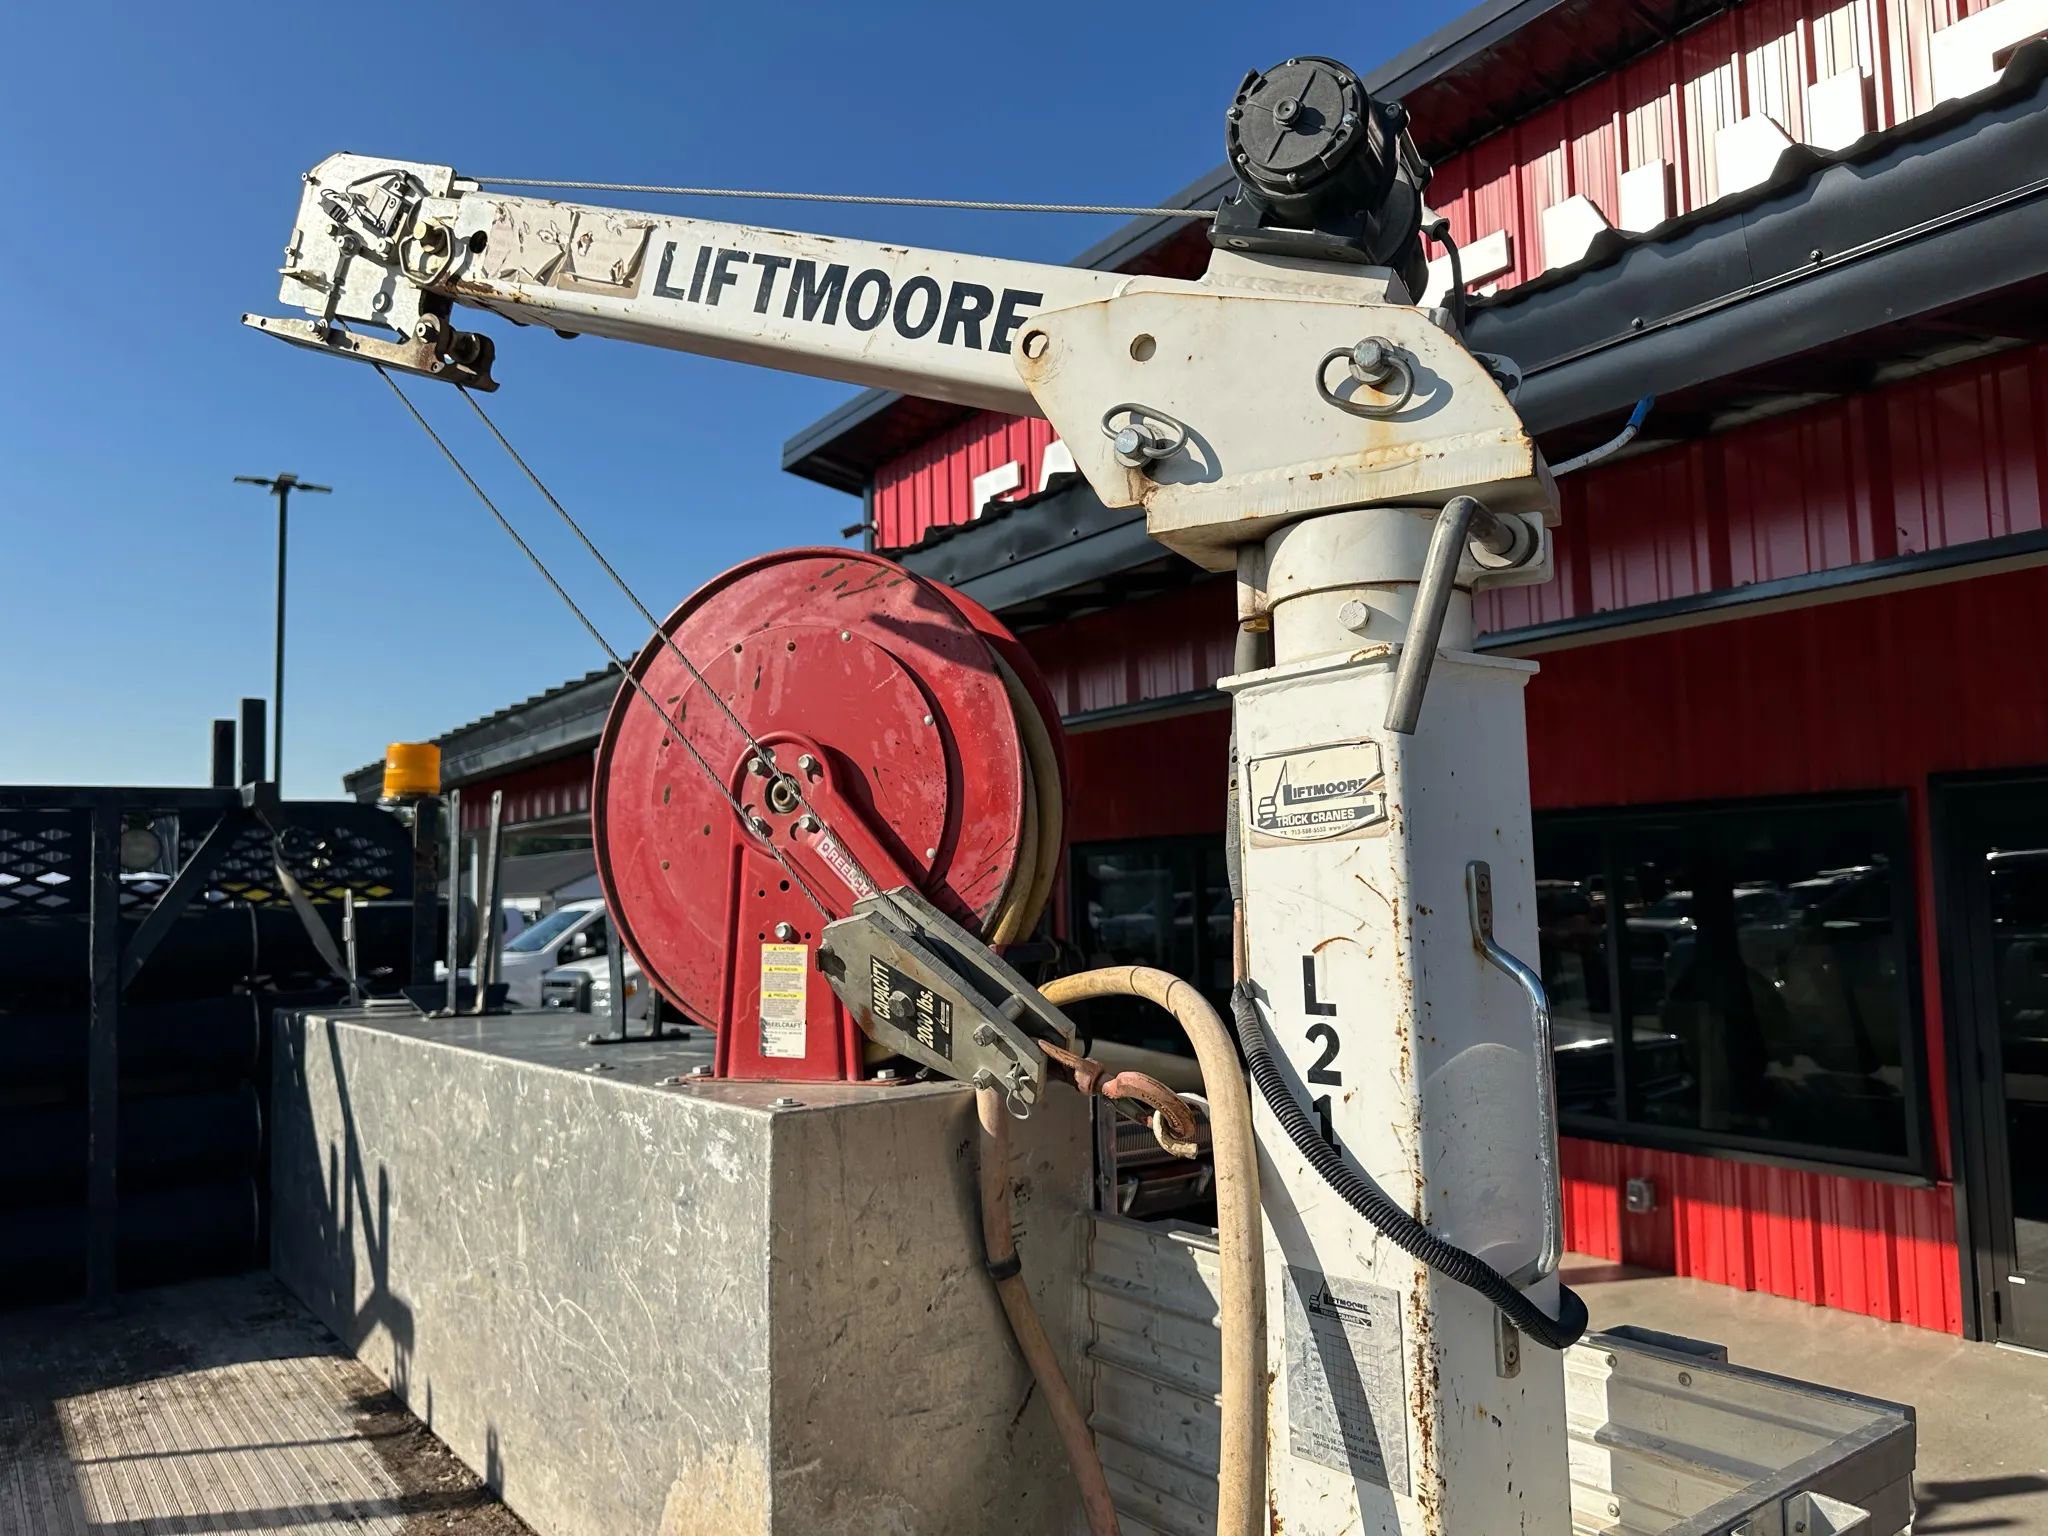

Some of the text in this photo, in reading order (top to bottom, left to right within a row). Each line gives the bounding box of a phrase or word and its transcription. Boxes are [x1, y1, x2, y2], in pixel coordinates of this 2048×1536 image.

[653, 241, 1043, 355] LIFTMOORE
[1276, 808, 1355, 827] TRUCK CRANES
[872, 958, 891, 1020] CAPACITY
[916, 990, 934, 1049] 2000 lbs.
